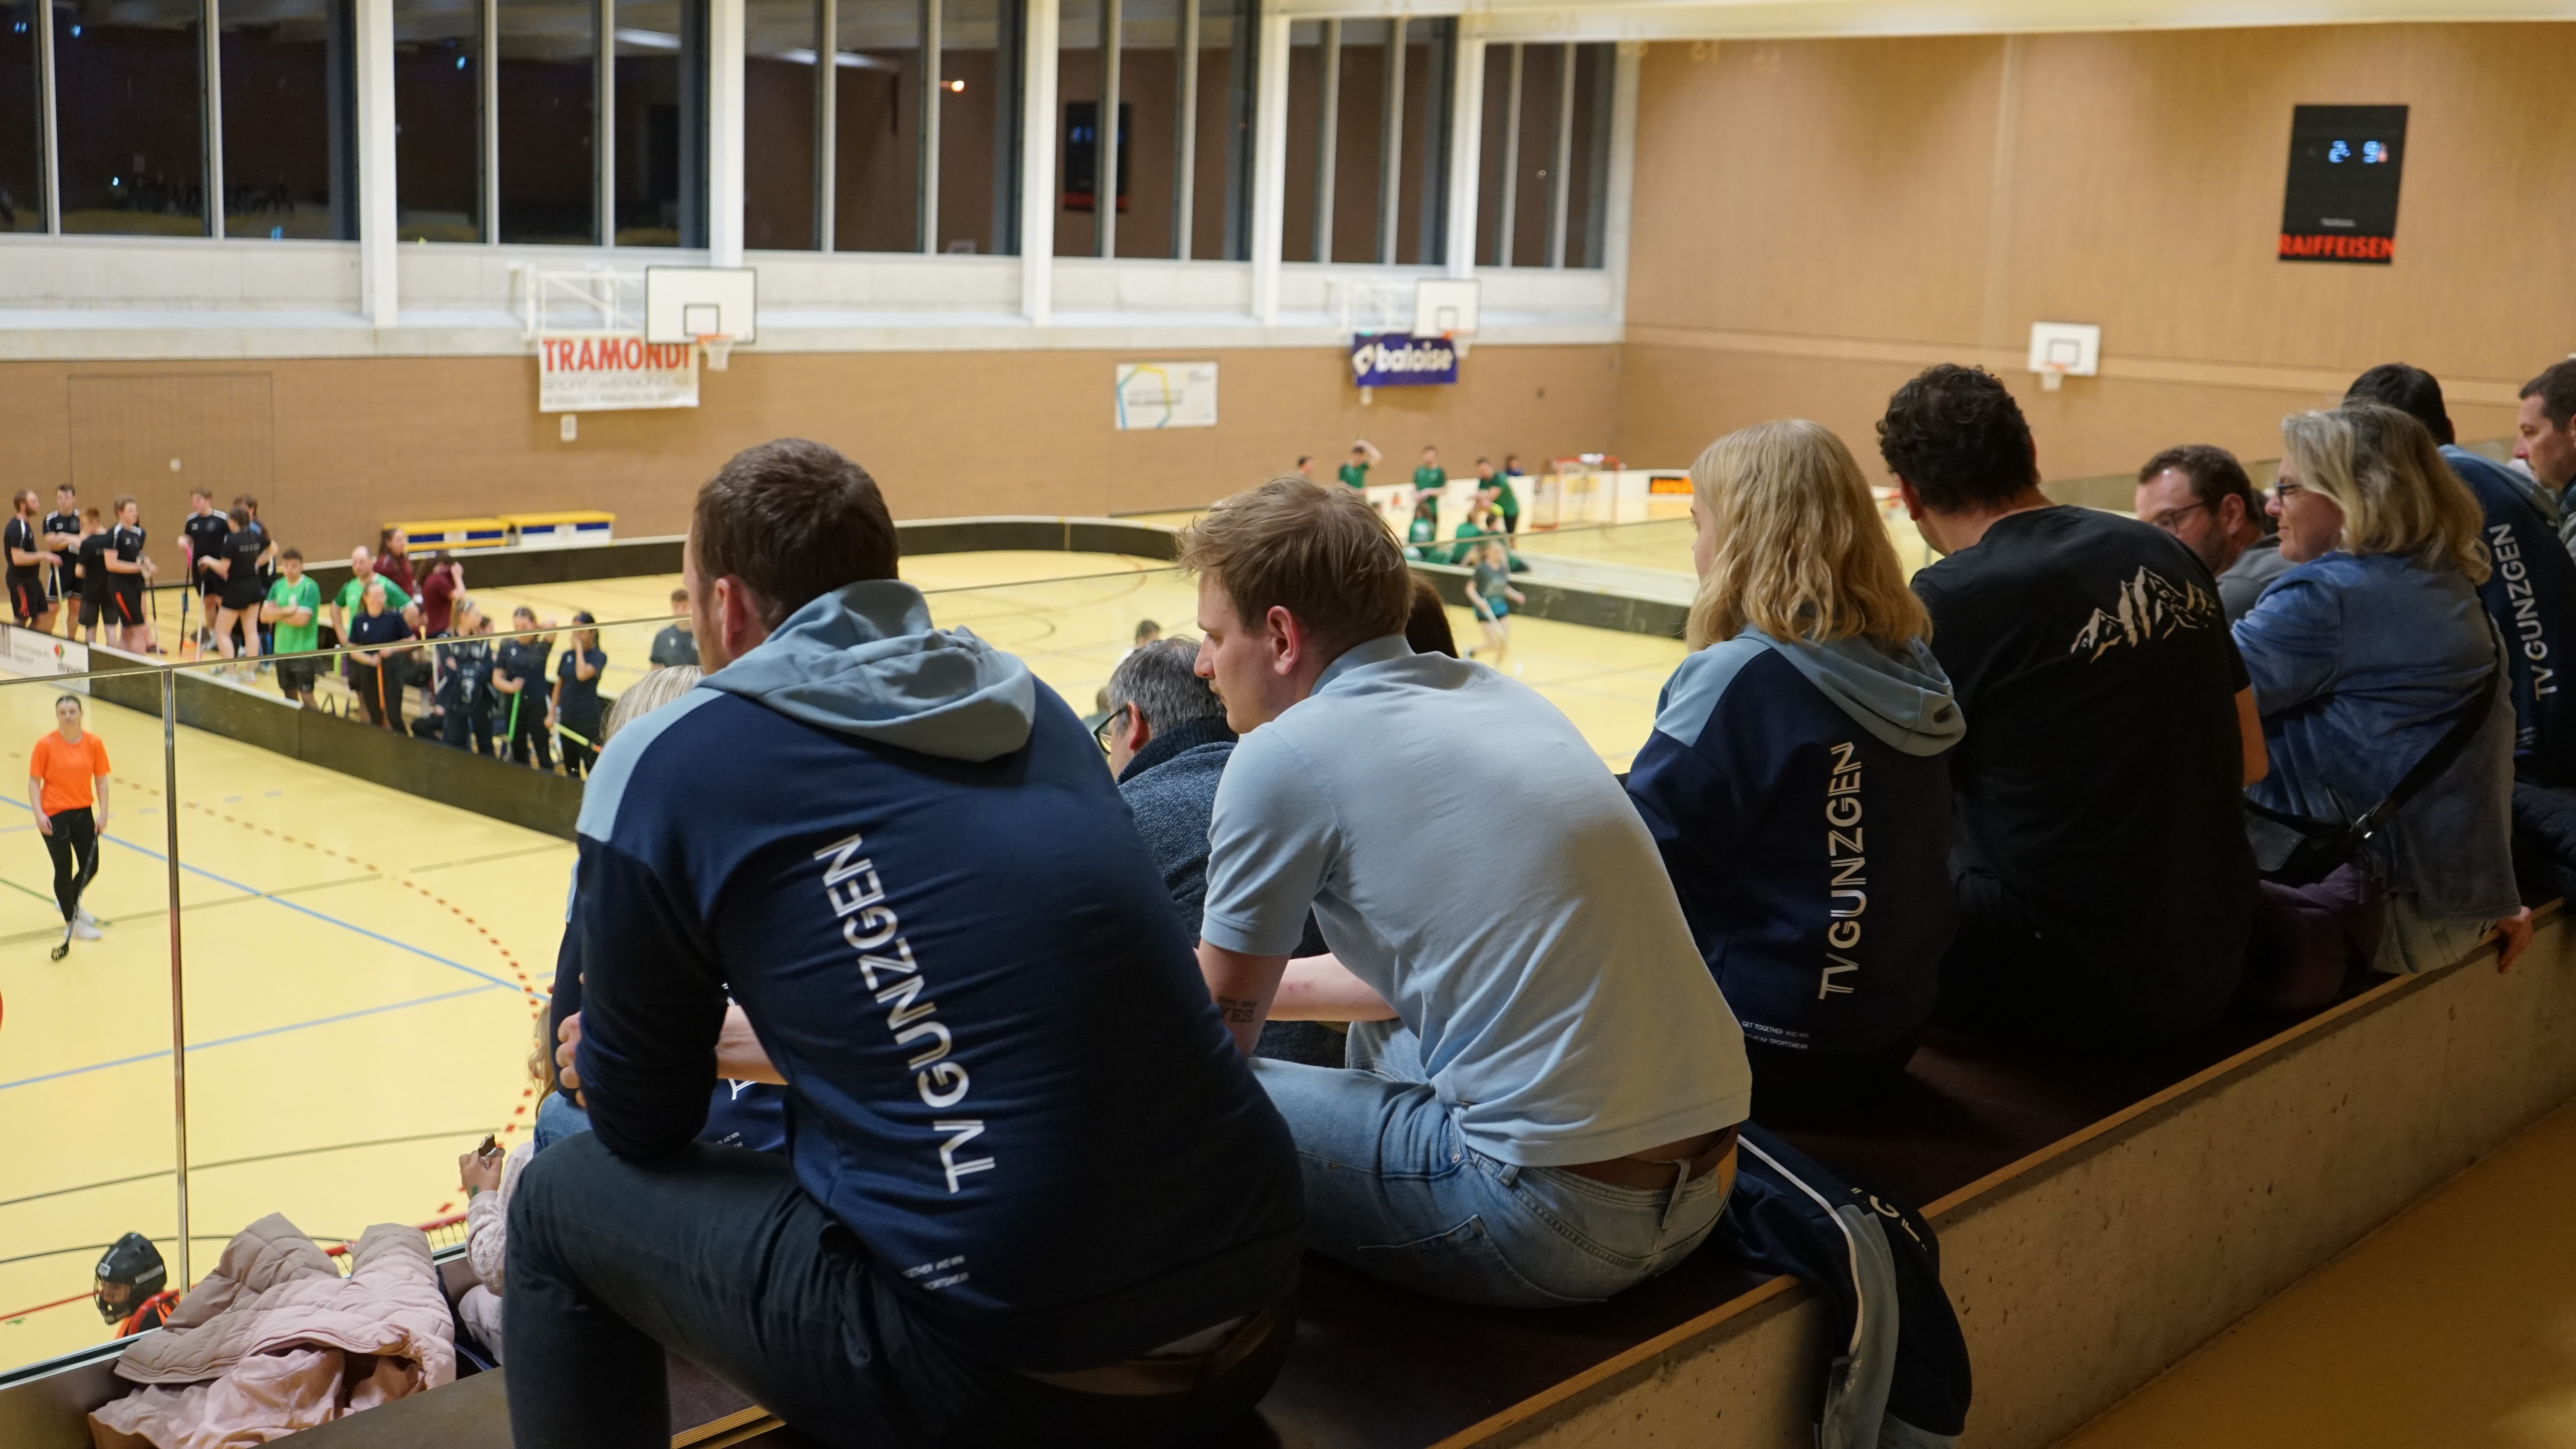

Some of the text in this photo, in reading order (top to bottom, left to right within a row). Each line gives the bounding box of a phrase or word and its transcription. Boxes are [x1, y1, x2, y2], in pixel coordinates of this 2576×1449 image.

[2279, 233, 2395, 258] RAIFFEISEN
[543, 337, 689, 371] TRAMONDI
[1375, 341, 1454, 373] baloise
[2488, 523, 2558, 702] TV GUNZGEN
[1818, 741, 1867, 1000] TV GUNZGEN
[814, 834, 969, 1107] GUNZGEN
[1755, 1024, 1783, 1034] TOGETHER
[1769, 1039, 1808, 1049] SPORTSWEAR
[933, 1120, 996, 1193] TV
